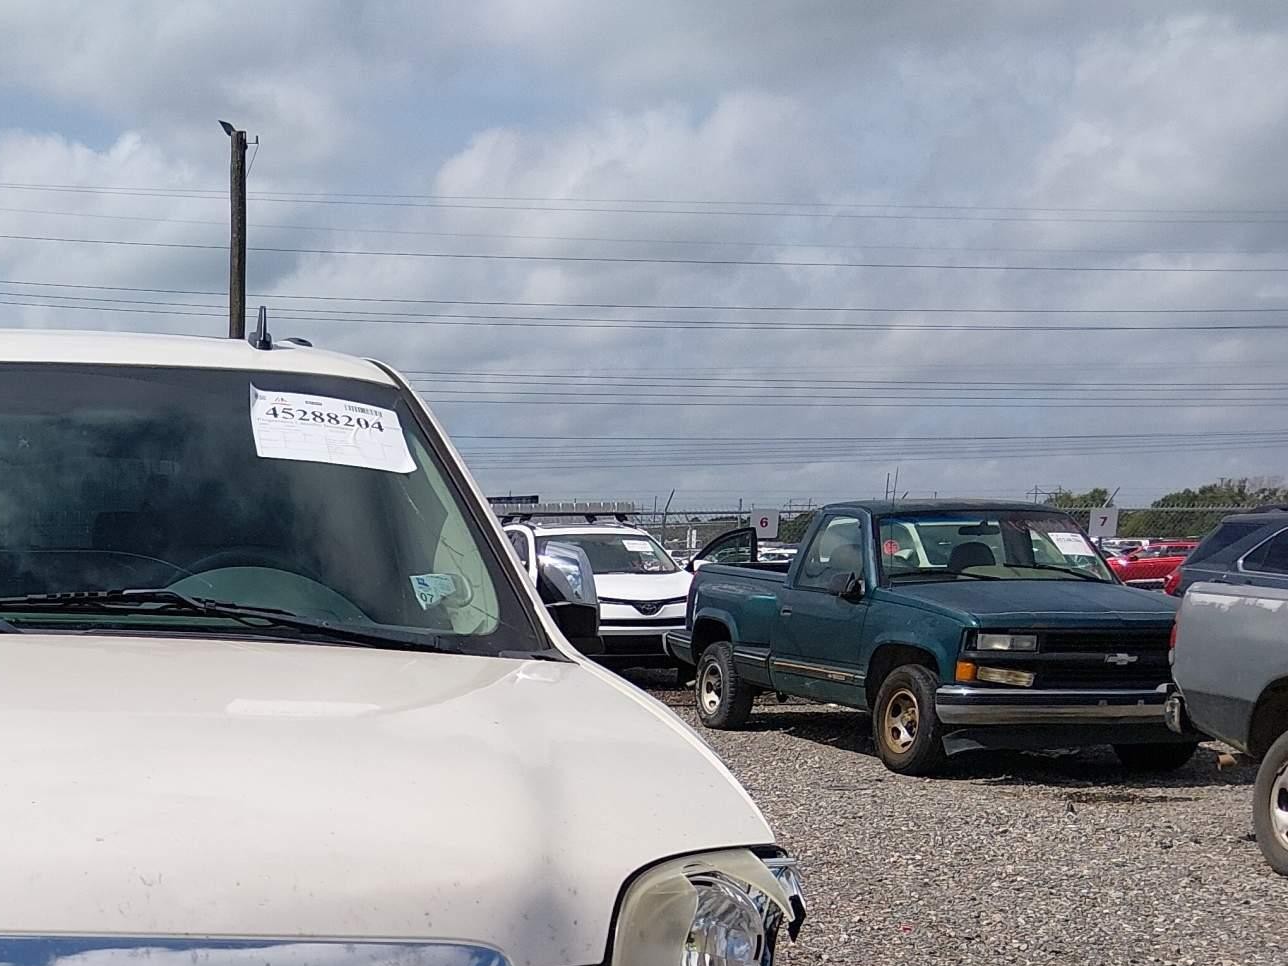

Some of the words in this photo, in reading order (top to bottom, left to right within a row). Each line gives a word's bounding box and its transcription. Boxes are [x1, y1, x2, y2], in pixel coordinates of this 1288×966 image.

[265, 406, 385, 432] 45288204
[759, 516, 769, 528] 6
[1099, 516, 1108, 527] 7
